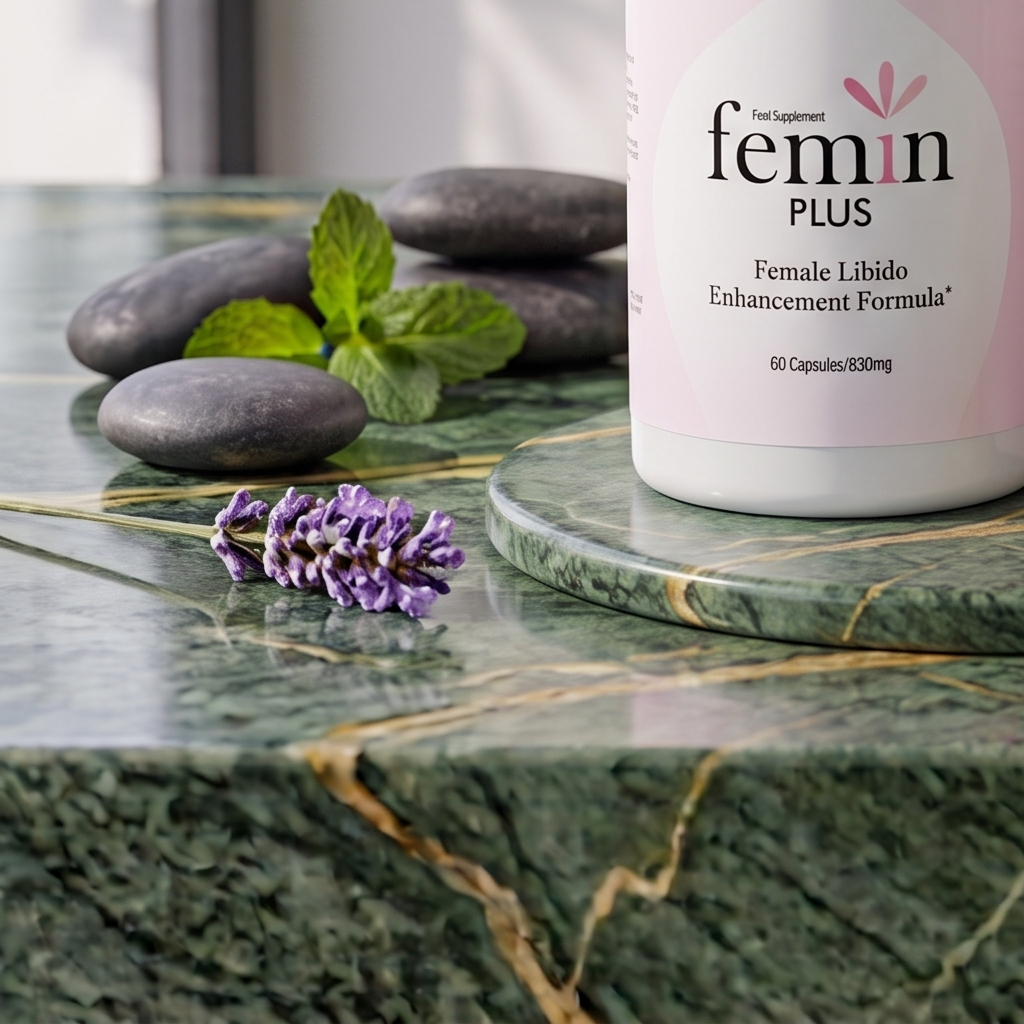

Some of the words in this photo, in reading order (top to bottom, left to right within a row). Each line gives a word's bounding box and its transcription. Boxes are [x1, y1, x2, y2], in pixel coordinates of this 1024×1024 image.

[773, 110, 825, 125] Supplement
[707, 100, 954, 185] femin
[790, 197, 872, 227] PLUS
[754, 259, 831, 282] Female
[838, 259, 908, 282] Libido
[709, 284, 851, 312] Enhancement
[770, 356, 786, 371] 60
[789, 356, 892, 375] Capsules/830mg
